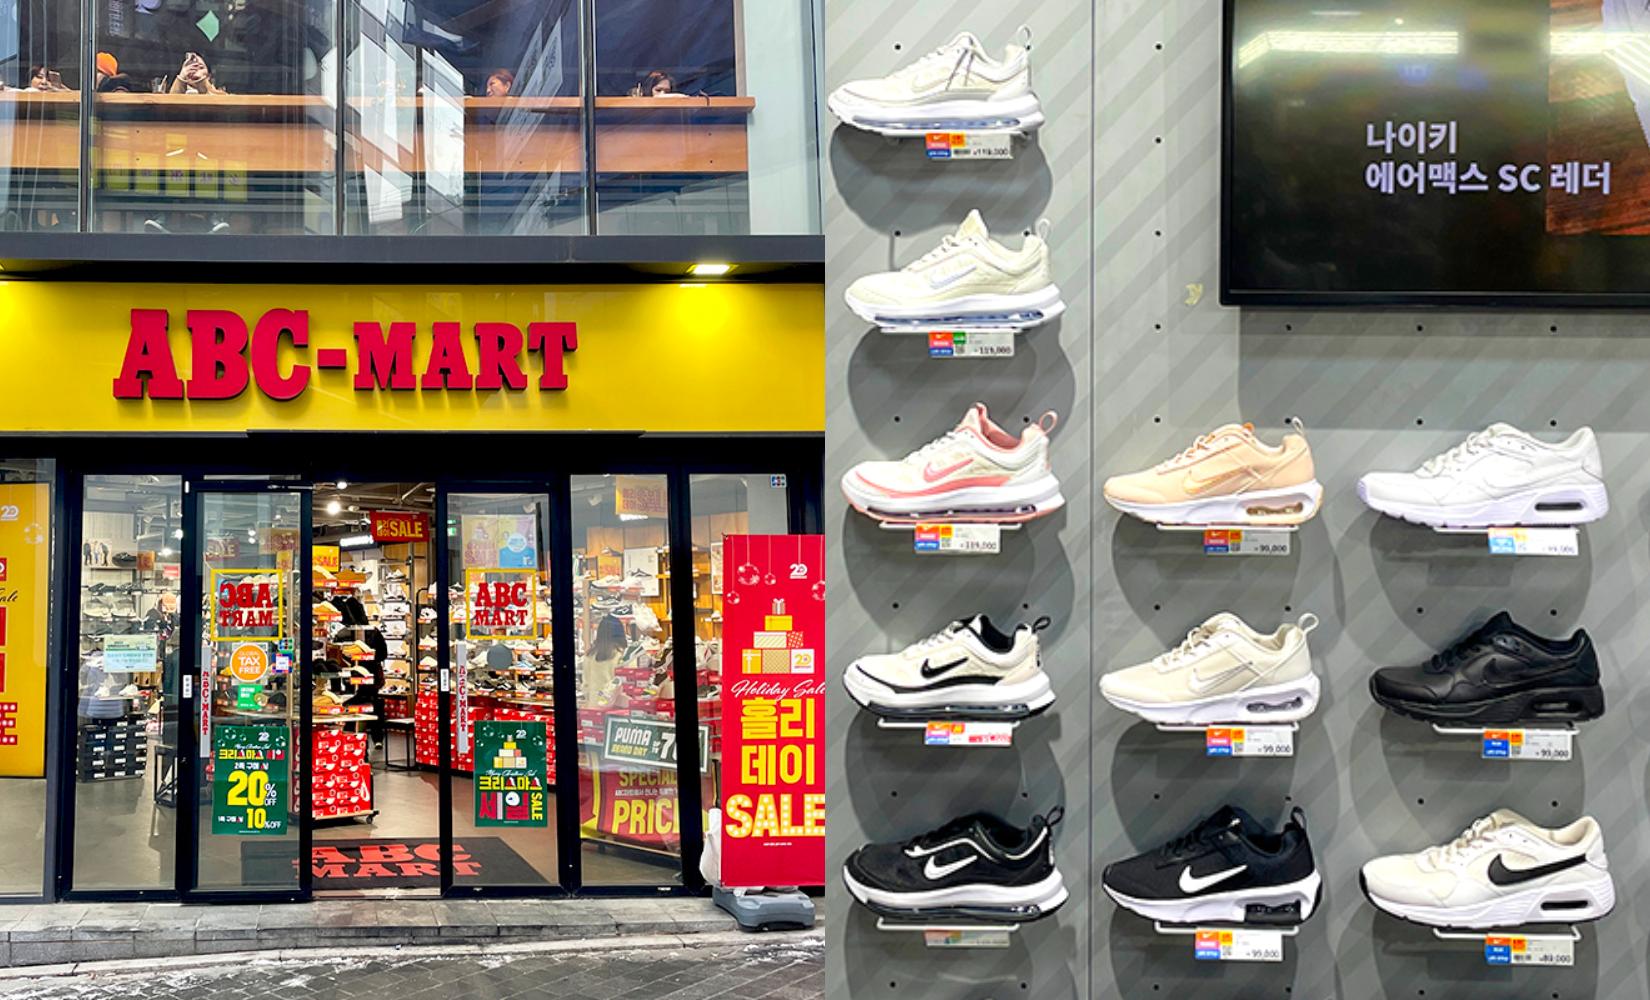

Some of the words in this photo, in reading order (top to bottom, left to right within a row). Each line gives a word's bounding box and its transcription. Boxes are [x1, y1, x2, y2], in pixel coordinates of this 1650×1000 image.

[1366, 120, 1457, 154] 나이키
[1365, 161, 1489, 194] 에어맥스
[1498, 164, 1541, 192] SC
[1550, 161, 1610, 194] 레더
[112, 308, 578, 401] ABC-MART
[390, 520, 422, 537] SALE
[475, 583, 527, 606] ABC
[475, 610, 528, 626] MART
[238, 656, 260, 666] TAX
[731, 679, 790, 702] Holiday
[741, 697, 815, 739] 홀리
[615, 726, 653, 747] PUMA
[741, 744, 815, 785] 데이
[227, 770, 269, 806] 20
[479, 776, 543, 791] 크리스마스
[246, 808, 267, 829] 10
[479, 791, 530, 820] 세일
[531, 792, 543, 821] SALE
[725, 793, 825, 838] SALE
